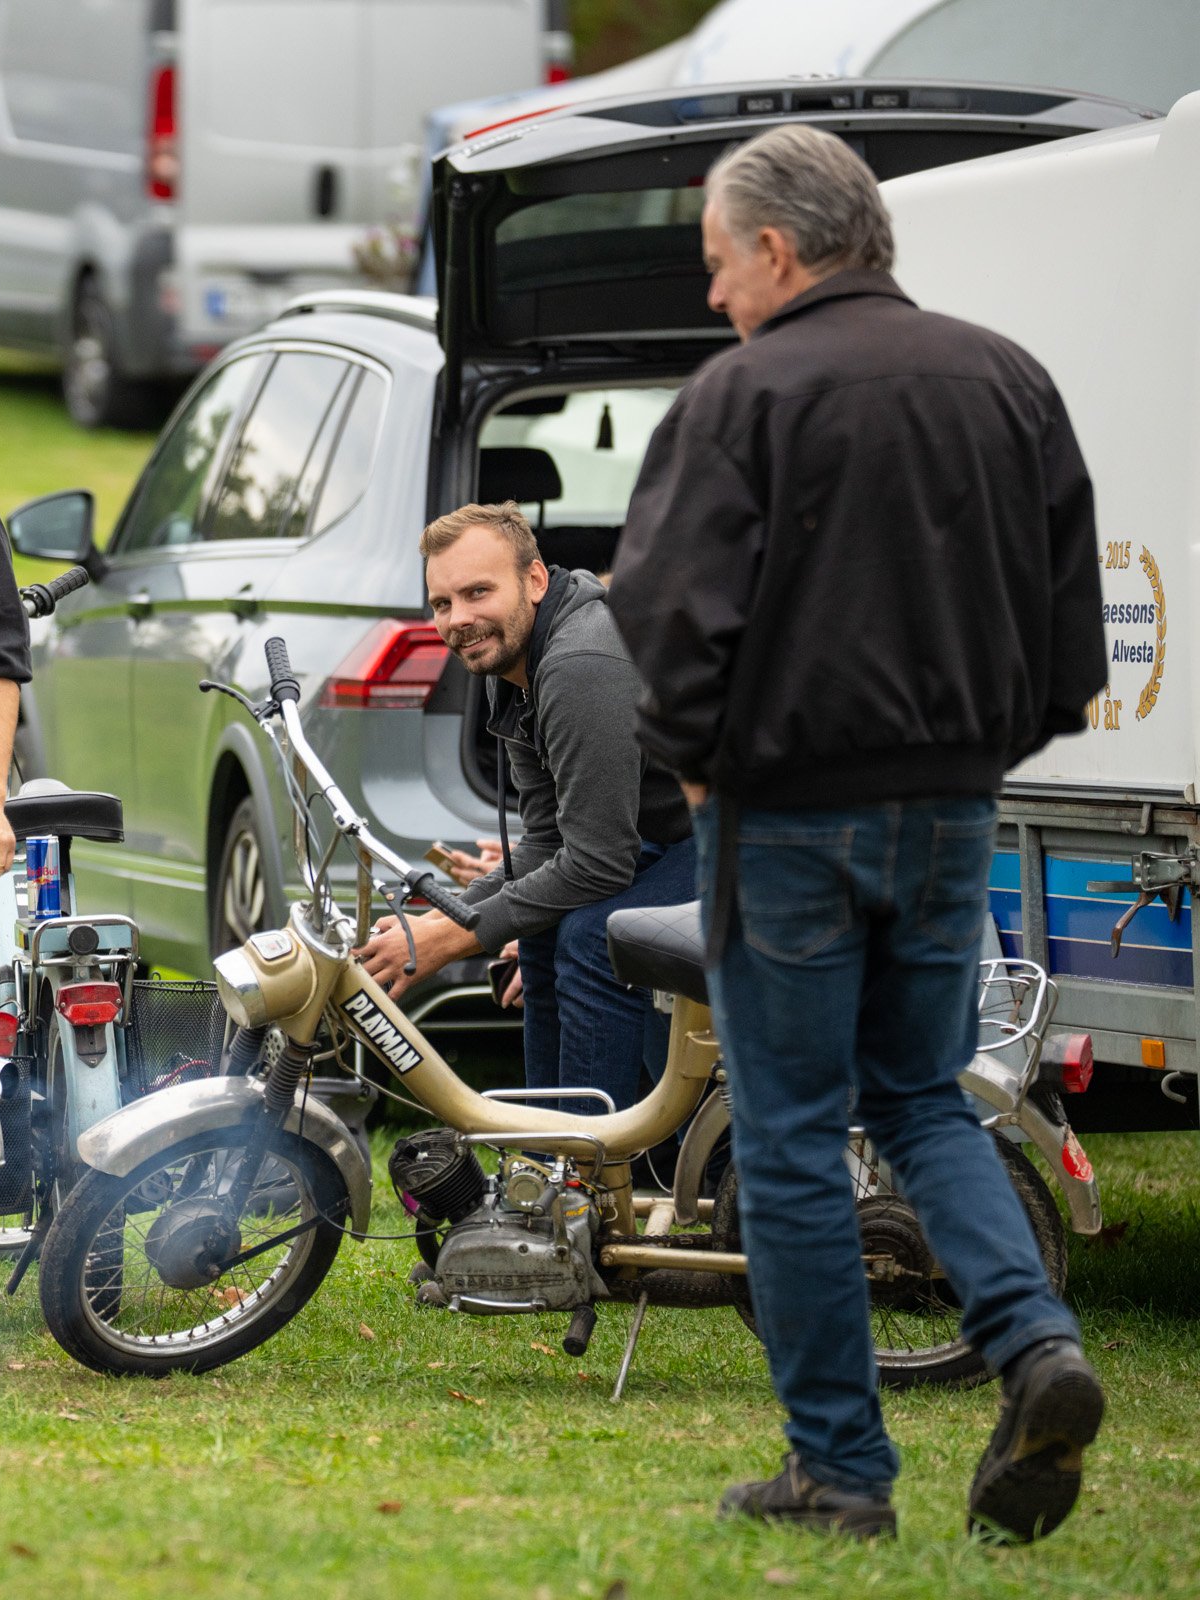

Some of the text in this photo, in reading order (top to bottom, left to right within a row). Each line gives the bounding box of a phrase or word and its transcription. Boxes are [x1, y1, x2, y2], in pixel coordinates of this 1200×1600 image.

[1105, 541, 1132, 570] 2015
[1102, 603, 1155, 625] aessons
[1112, 639, 1154, 664] Alvesta
[1104, 683, 1123, 731] år
[344, 993, 421, 1073] PLAYMAN
